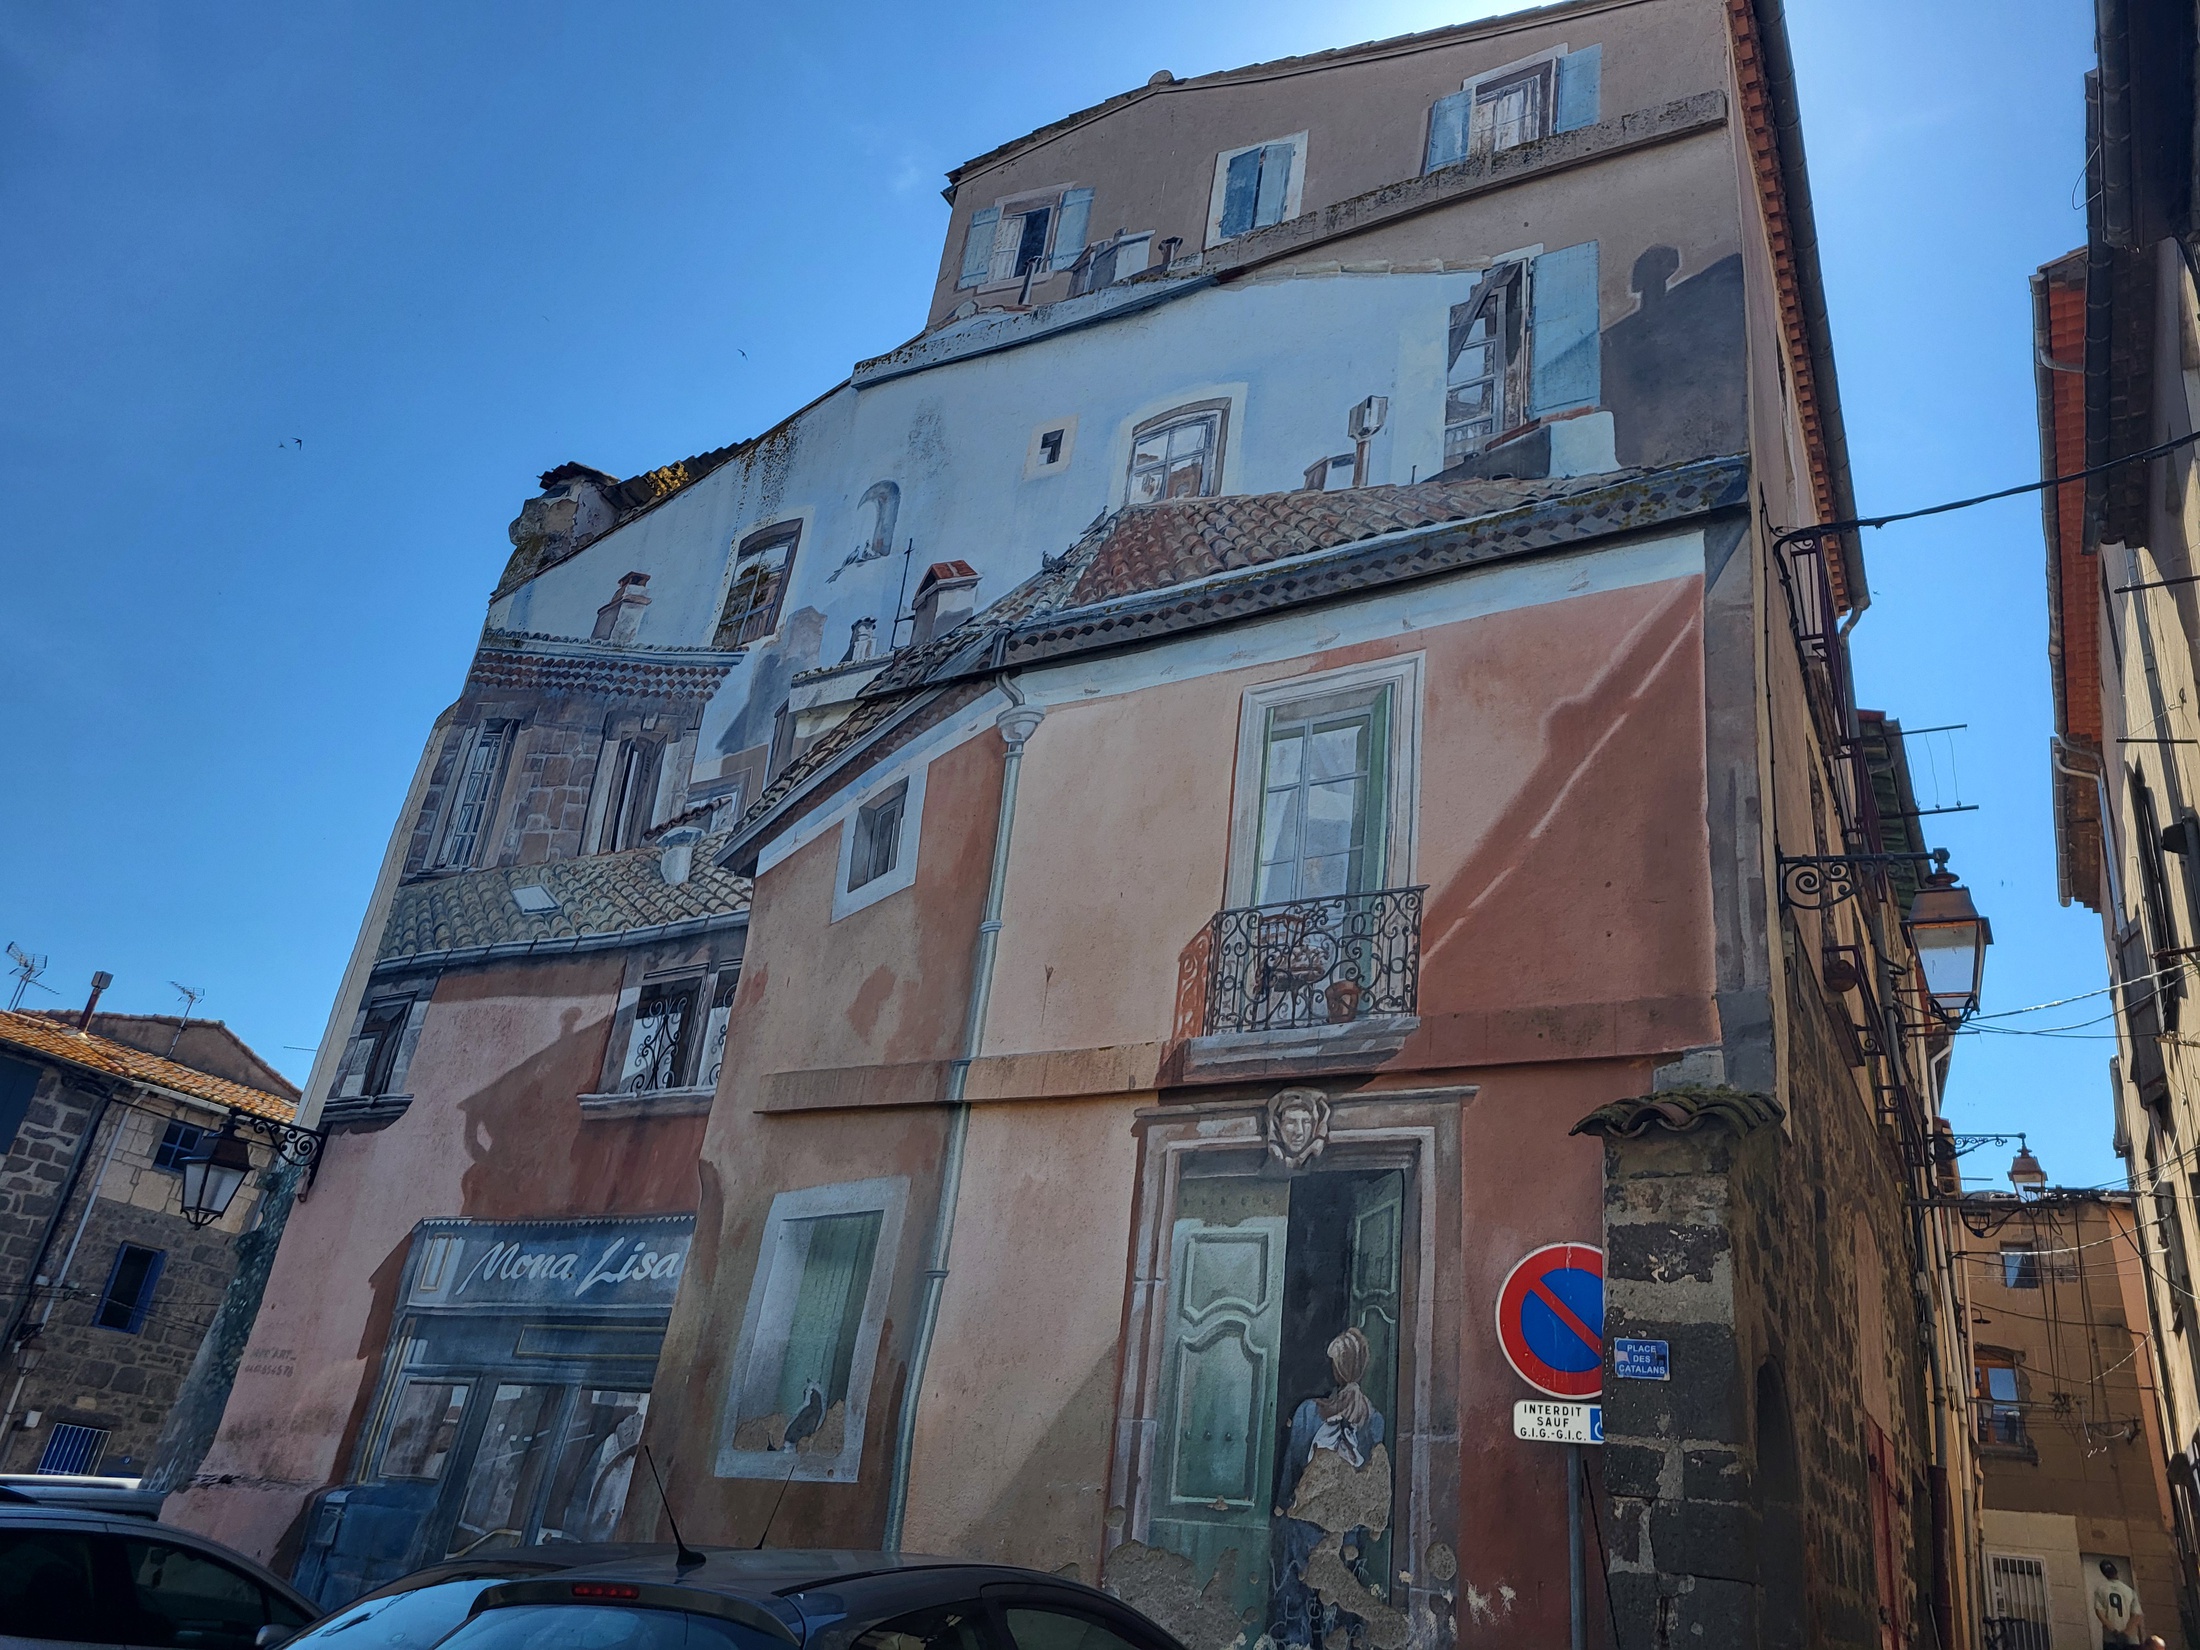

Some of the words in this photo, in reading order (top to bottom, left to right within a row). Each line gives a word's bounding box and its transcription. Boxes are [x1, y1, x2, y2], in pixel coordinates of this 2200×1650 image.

[455, 1240, 577, 1295] Mona
[574, 1236, 681, 1297] Lisa
[1627, 1344, 1657, 1353] PLACE
[1632, 1354, 1651, 1364] DES
[1618, 1364, 1666, 1375] CATALANS
[1524, 1404, 1582, 1416] INTERDIT
[1536, 1416, 1570, 1428] SAUF
[1520, 1427, 1587, 1441] G.I.G.-G.I.C.
[2109, 1592, 2123, 1617] 9
